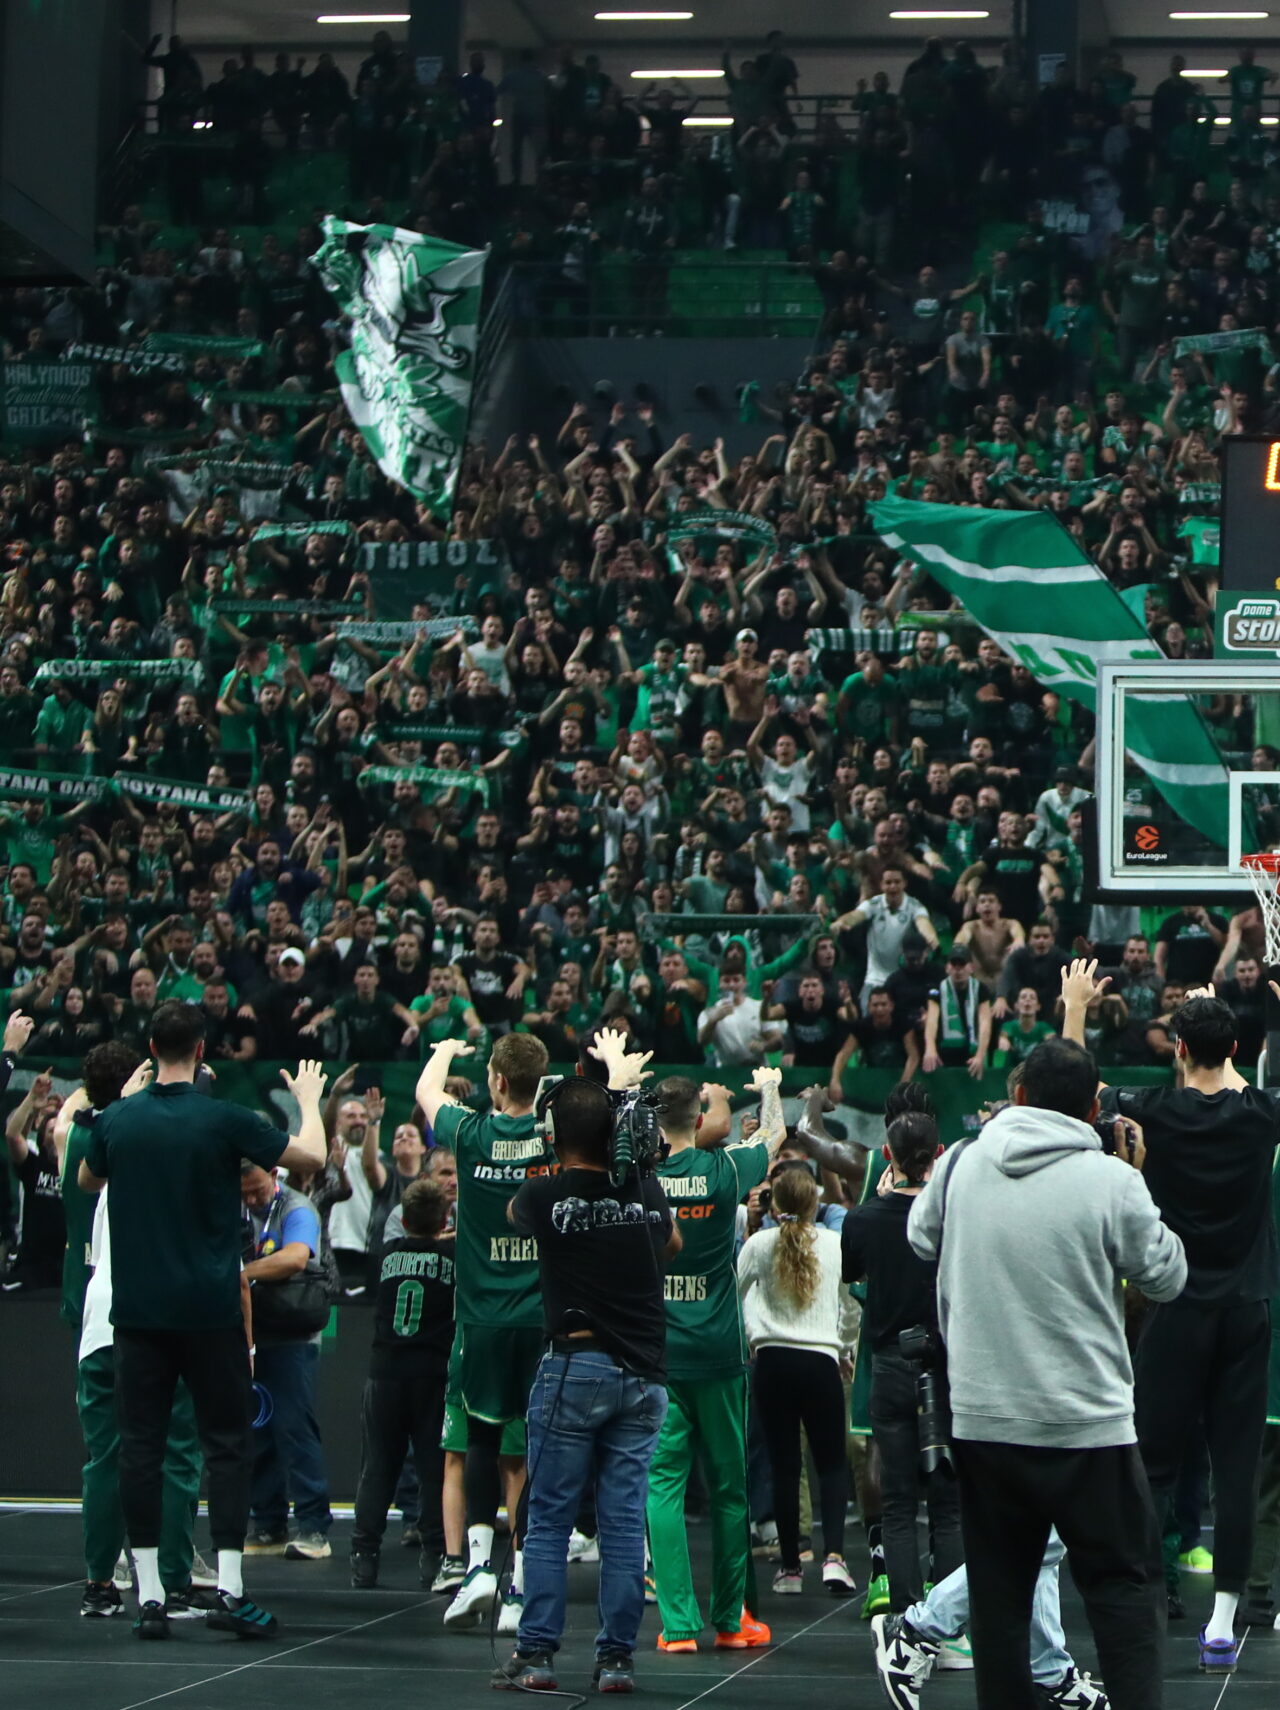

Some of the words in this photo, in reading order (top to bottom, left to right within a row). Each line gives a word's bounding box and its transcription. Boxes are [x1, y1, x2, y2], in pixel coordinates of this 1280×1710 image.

[1242, 605, 1273, 617] pame
[1126, 852, 1168, 862] EuroLeague
[491, 1136, 545, 1161] GRIGONIS
[380, 1251, 439, 1282] SHORTS
[393, 1279, 424, 1336] 0
